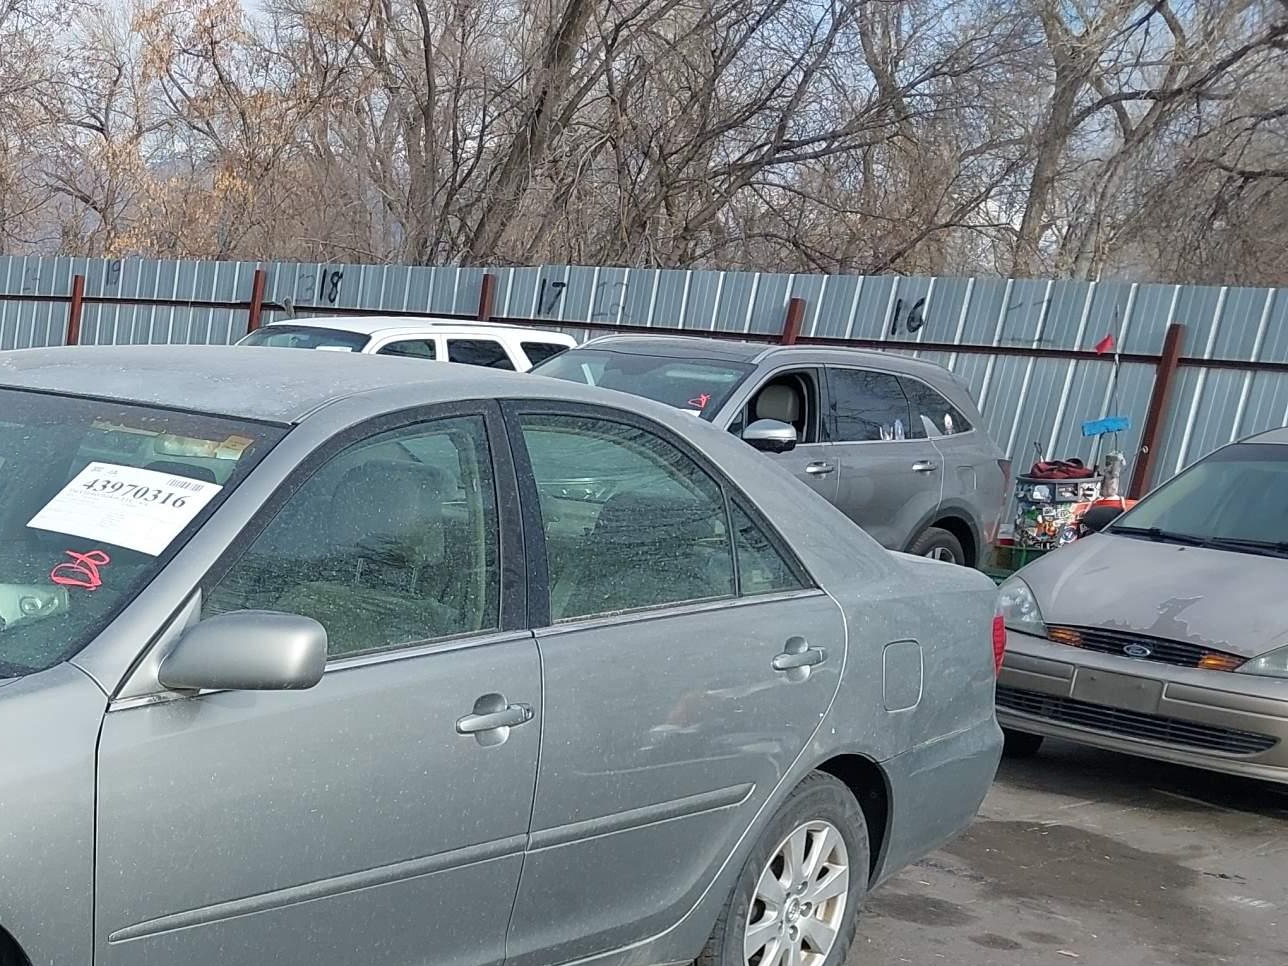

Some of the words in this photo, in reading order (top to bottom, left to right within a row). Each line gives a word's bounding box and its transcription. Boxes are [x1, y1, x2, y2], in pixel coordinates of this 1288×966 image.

[105, 259, 121, 286] 19
[319, 268, 344, 303] 18
[537, 278, 566, 315] 17
[891, 298, 926, 335] 16
[82, 478, 191, 509] 43970316
